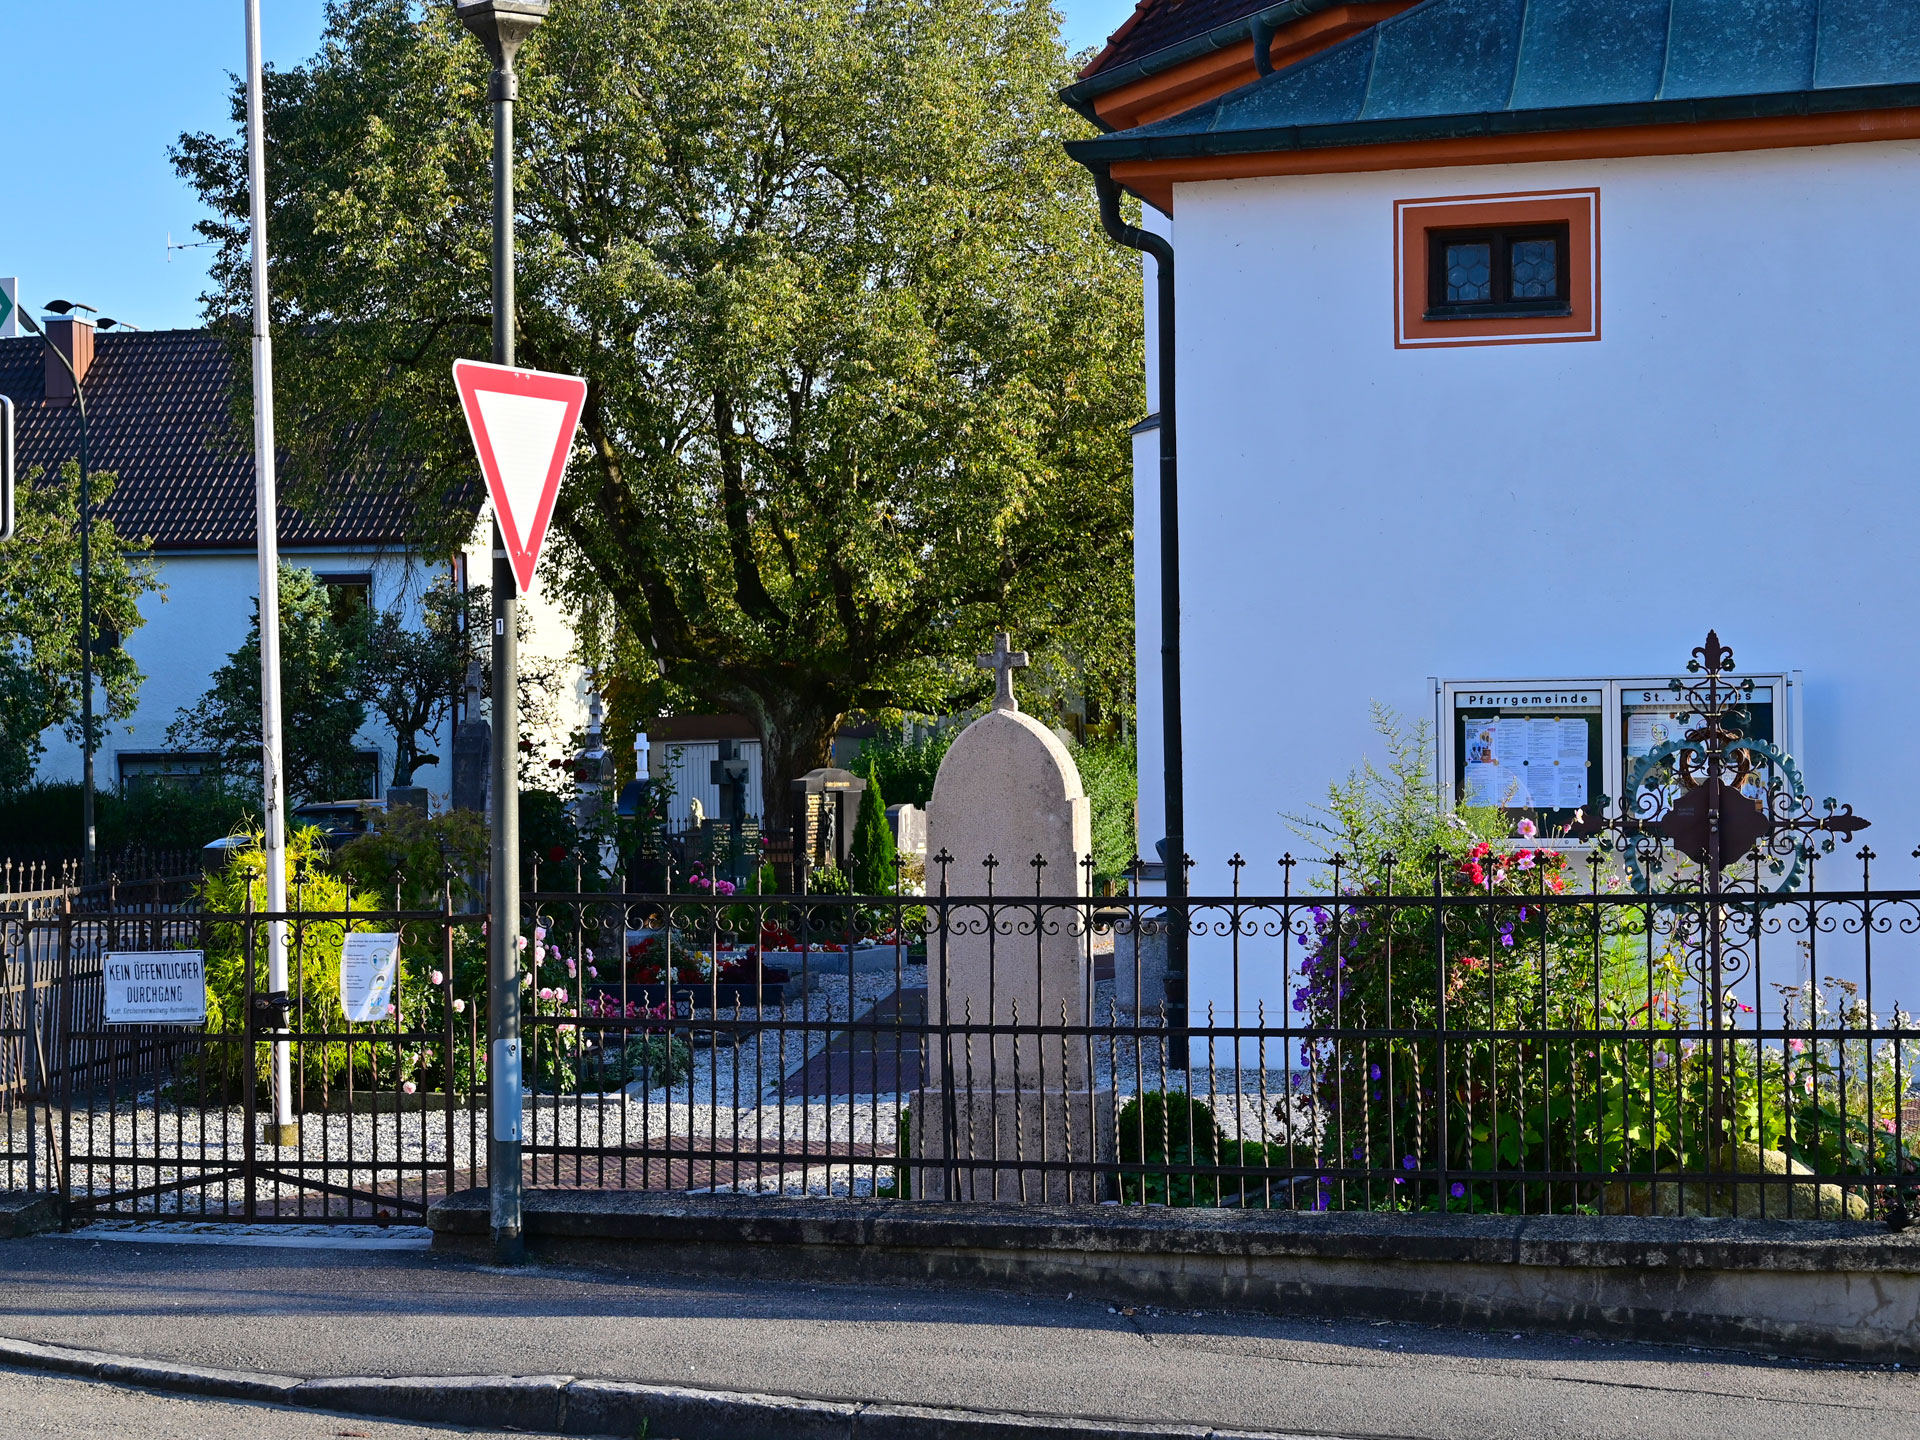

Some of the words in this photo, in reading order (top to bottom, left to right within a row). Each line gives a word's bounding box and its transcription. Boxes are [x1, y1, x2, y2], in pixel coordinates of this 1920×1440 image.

[1469, 694, 1588, 706] Pfarrgemeinde
[1643, 692, 1665, 702] St.
[109, 964, 131, 981] KEIN
[133, 961, 200, 980] ÖFFENTLICHER
[127, 985, 183, 1003] DURCHGANG
